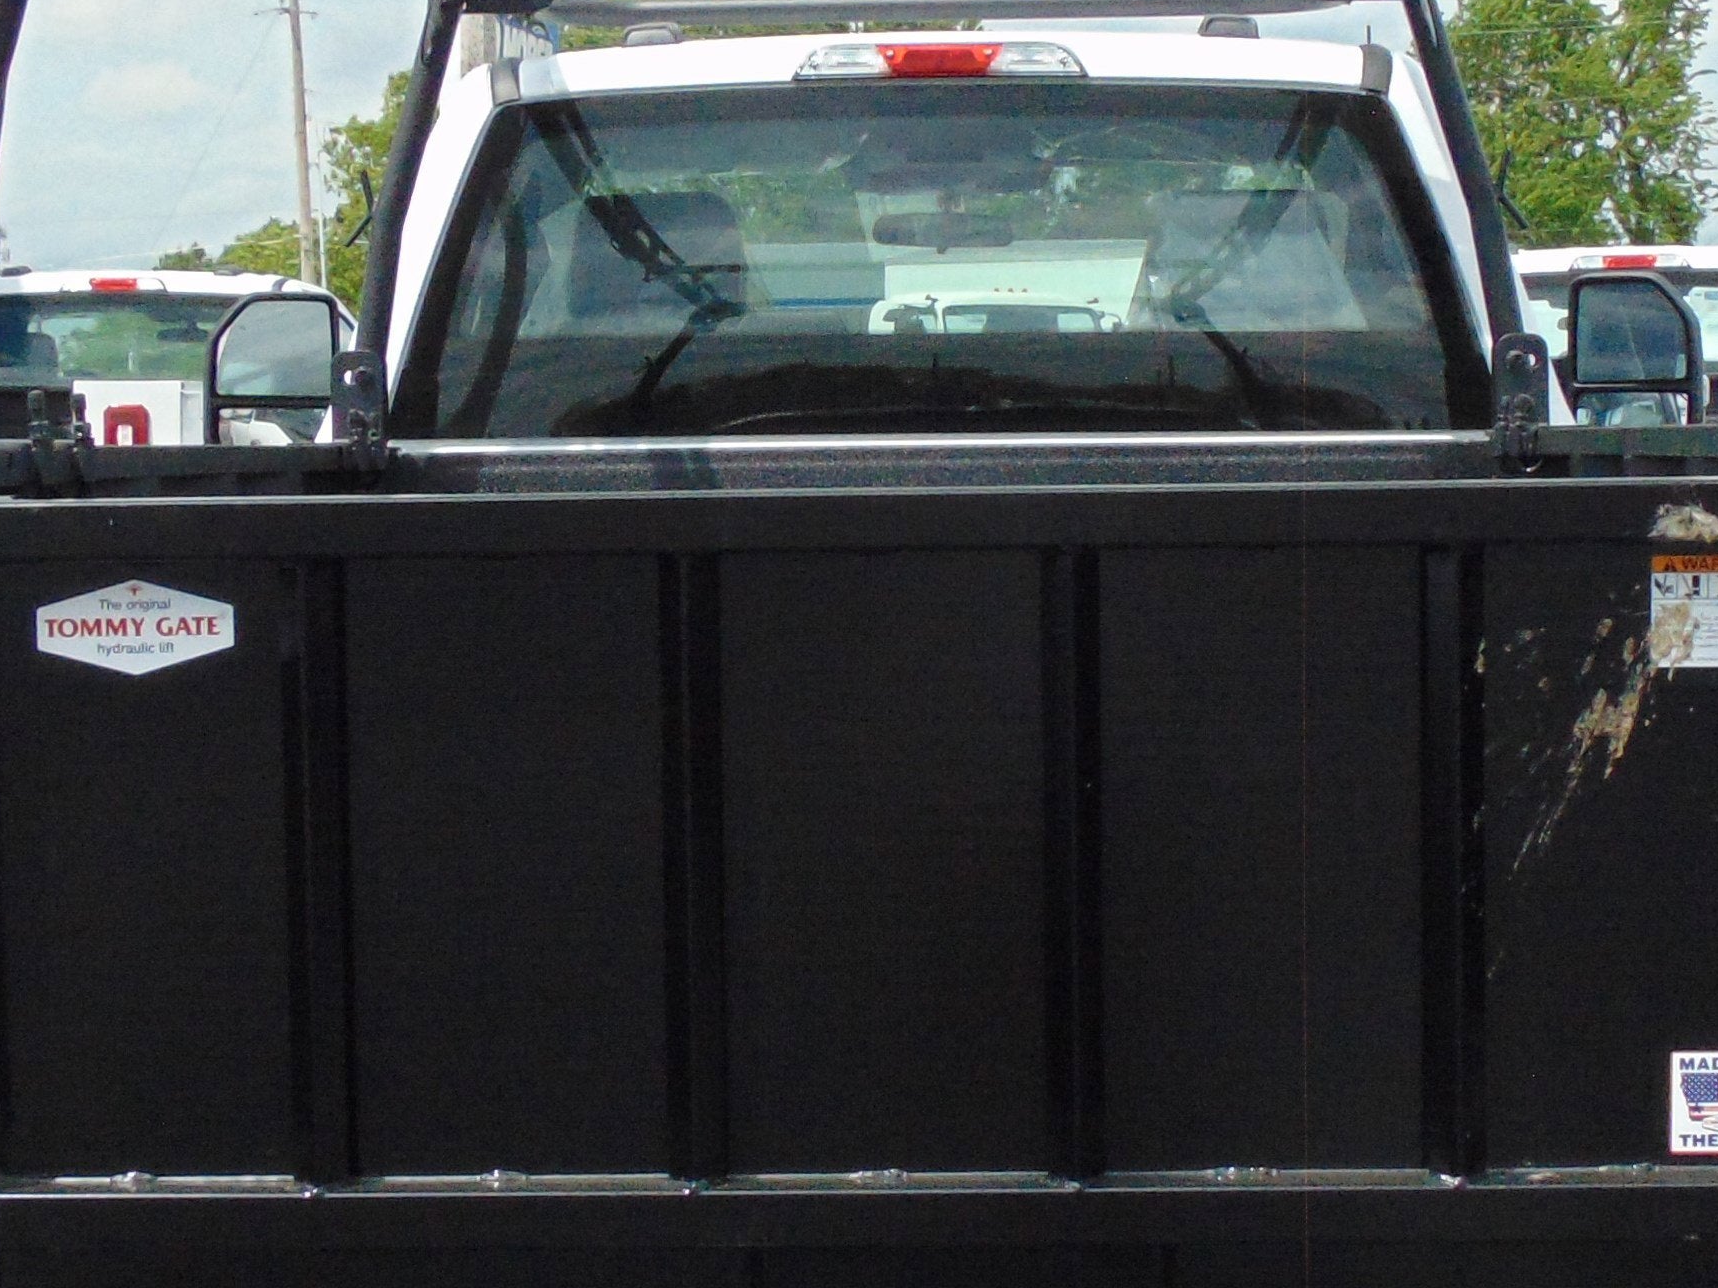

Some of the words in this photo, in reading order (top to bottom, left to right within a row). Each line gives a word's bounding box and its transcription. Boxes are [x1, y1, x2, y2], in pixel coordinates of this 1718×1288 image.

[99, 599, 122, 611] The
[126, 598, 171, 611] original
[44, 617, 145, 638] TOMMY
[155, 616, 221, 636] GATE
[97, 641, 155, 656] hydraulic
[159, 641, 175, 654] lift
